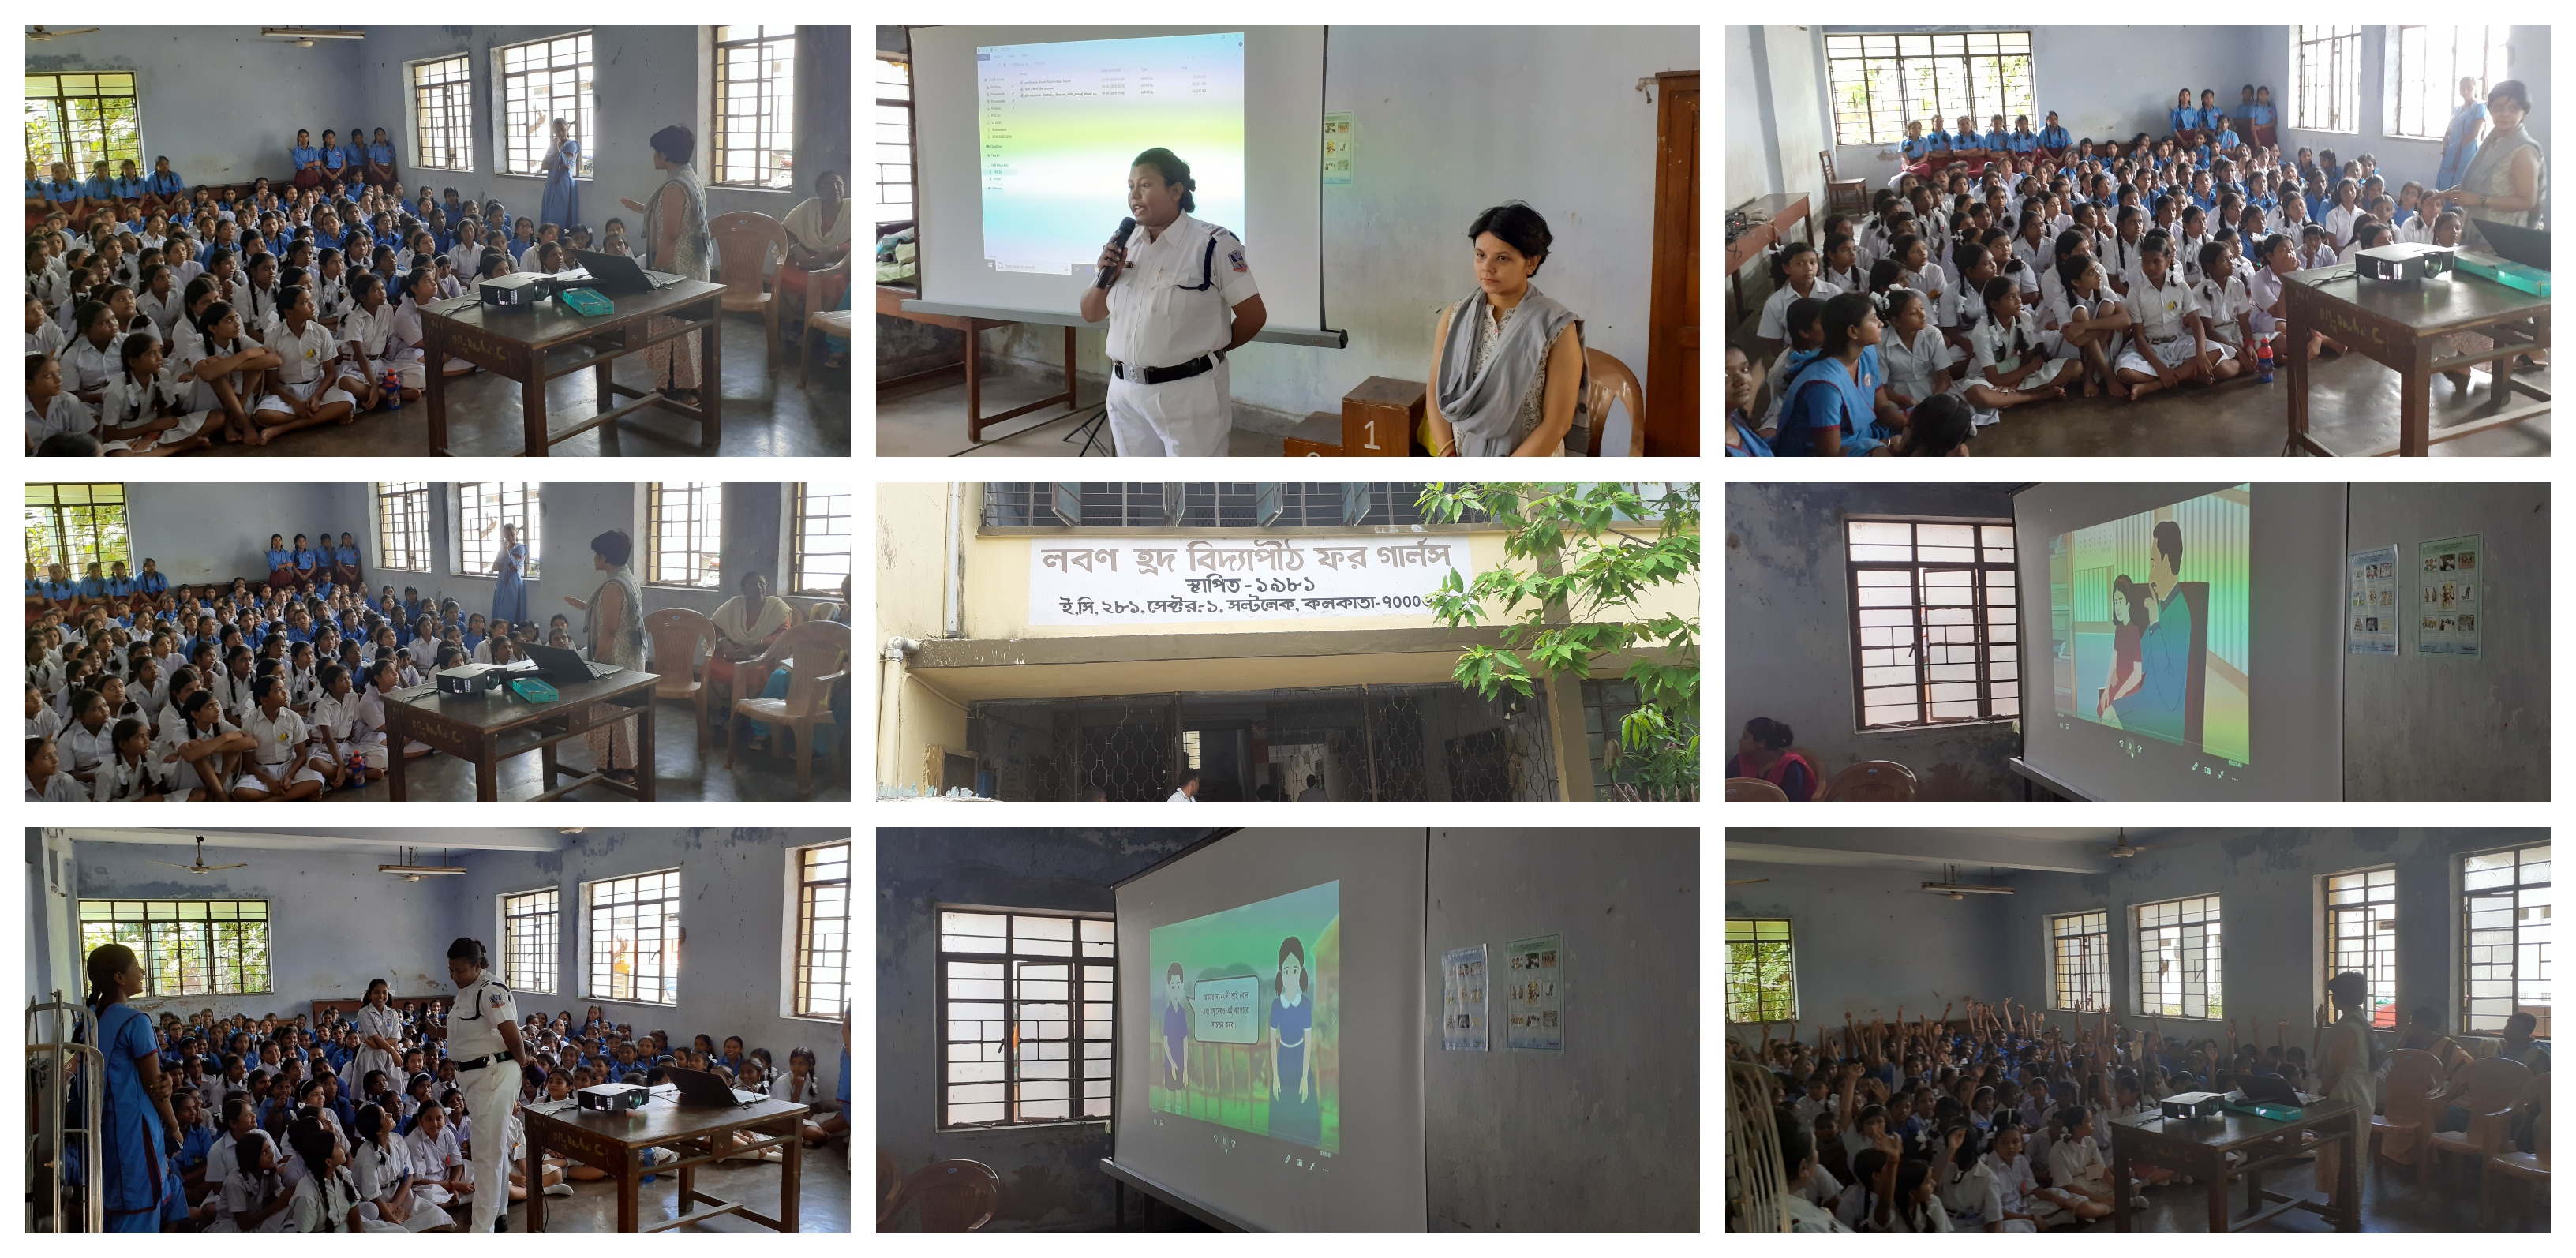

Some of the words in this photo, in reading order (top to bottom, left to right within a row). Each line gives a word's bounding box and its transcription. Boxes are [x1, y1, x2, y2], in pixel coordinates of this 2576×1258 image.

[1363, 420, 1381, 451] 1
[1041, 549, 1119, 574] লবণ
[1133, 549, 1178, 577] হ্রদ
[1186, 539, 1305, 572] বিদ্যাপীঠ
[1313, 546, 1368, 571] ফর
[1376, 537, 1452, 568] গার্লস
[1185, 573, 1241, 593] স্থাপিত
